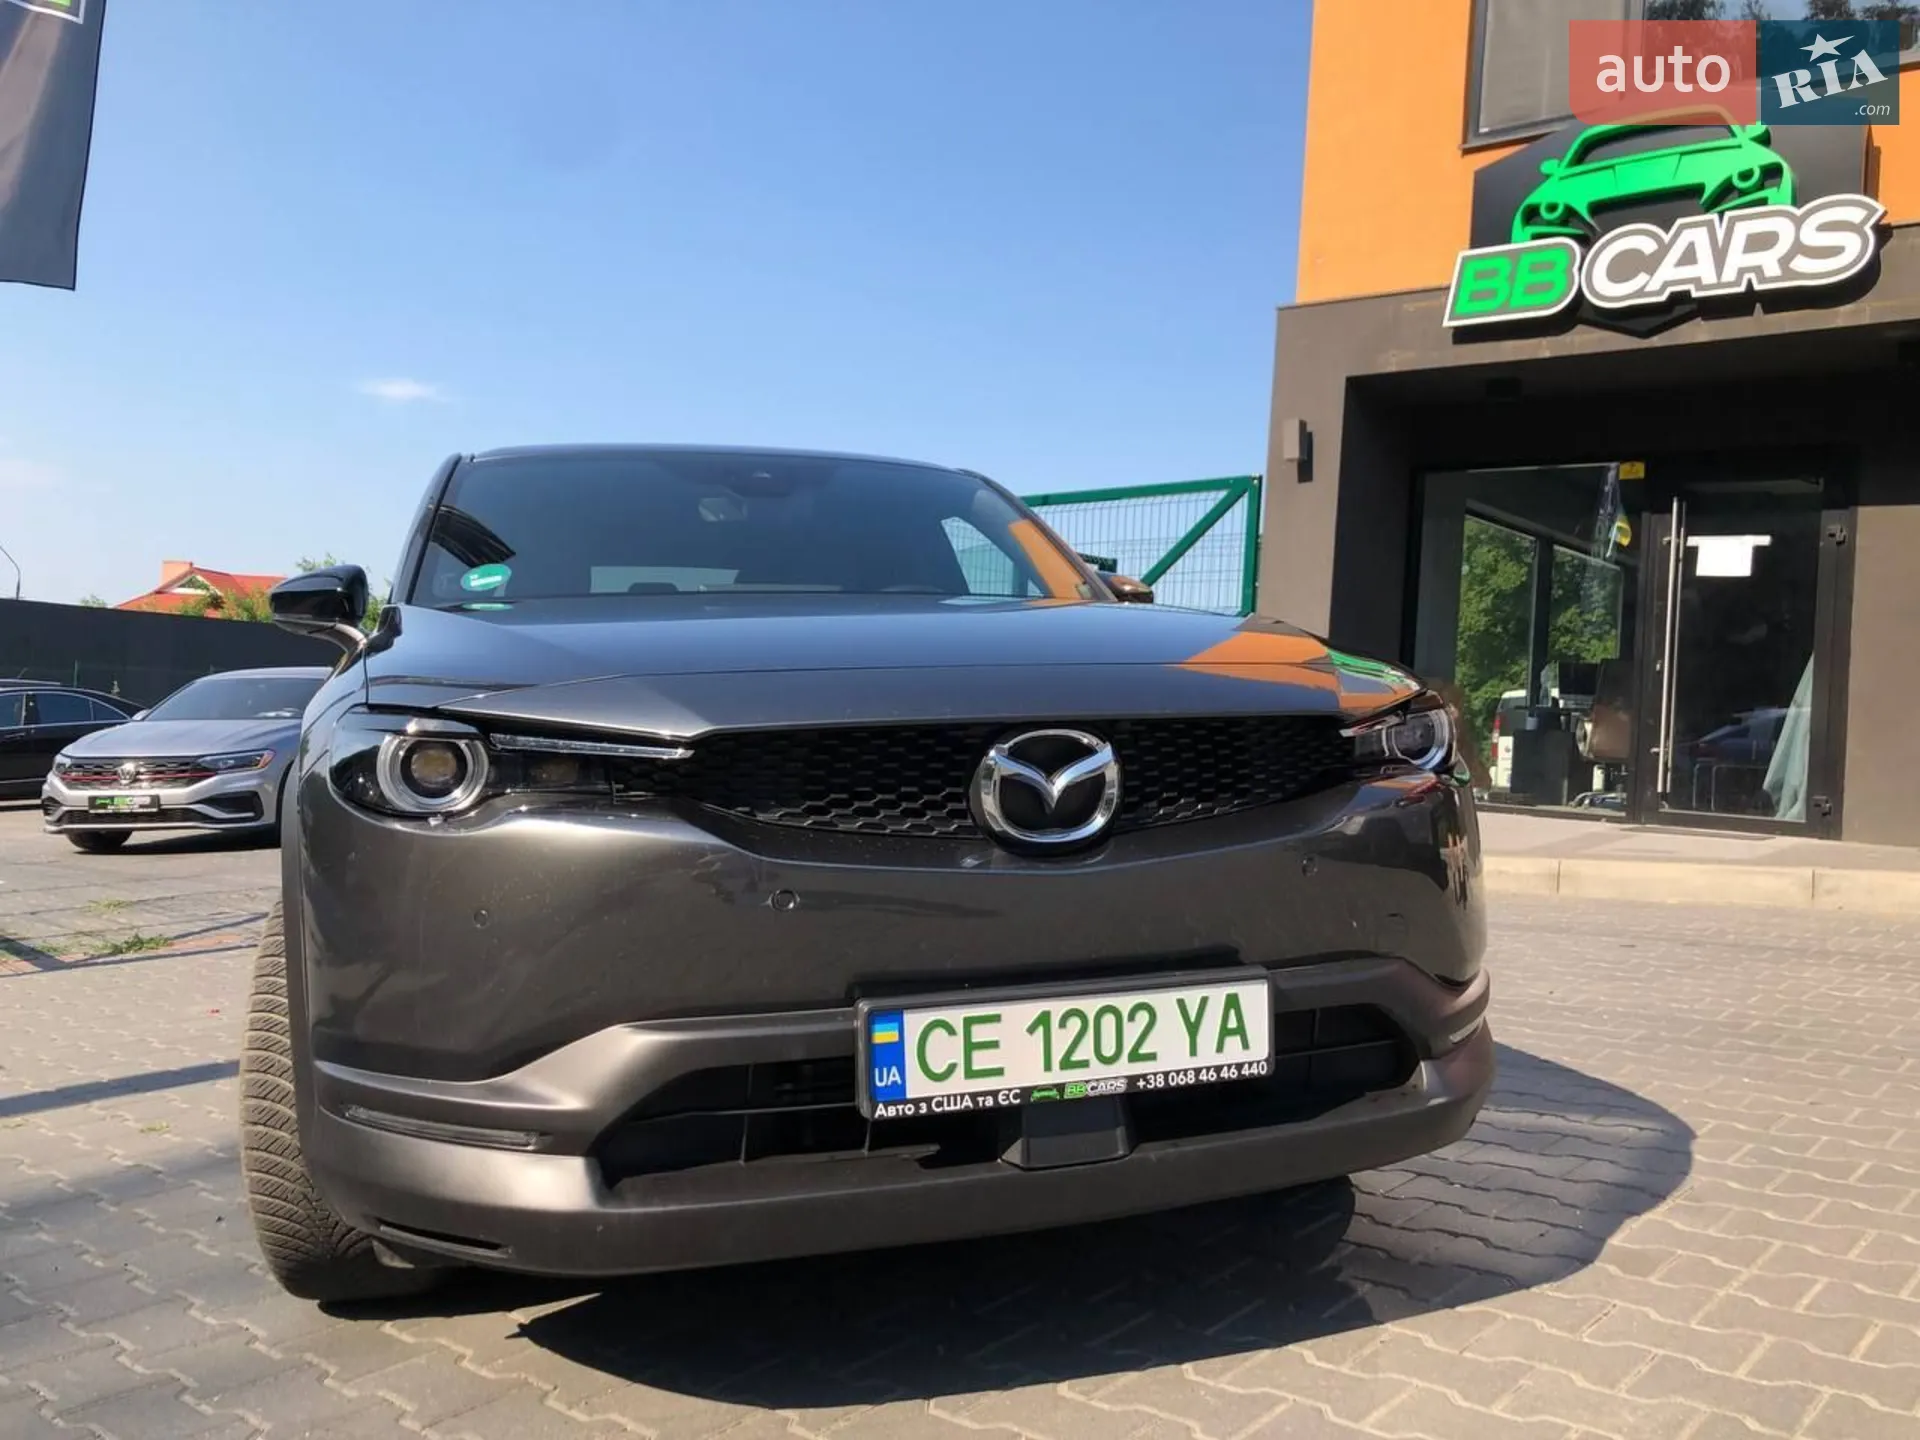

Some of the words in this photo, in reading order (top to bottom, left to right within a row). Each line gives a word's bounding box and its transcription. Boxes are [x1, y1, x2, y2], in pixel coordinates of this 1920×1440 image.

[916, 1013, 1005, 1083] CE
[1025, 1001, 1158, 1073] 1202
[1175, 992, 1250, 1057] YA
[874, 1065, 902, 1087] UA
[1136, 1073, 1165, 1089] +38
[1168, 1069, 1196, 1086] 068
[1199, 1068, 1217, 1081] 46
[1220, 1064, 1238, 1078] 46
[1241, 1061, 1267, 1076] 440
[874, 1102, 915, 1119] Авто
[931, 1095, 973, 1112] США
[976, 1096, 994, 1107] та
[997, 1088, 1021, 1105] ЄС
